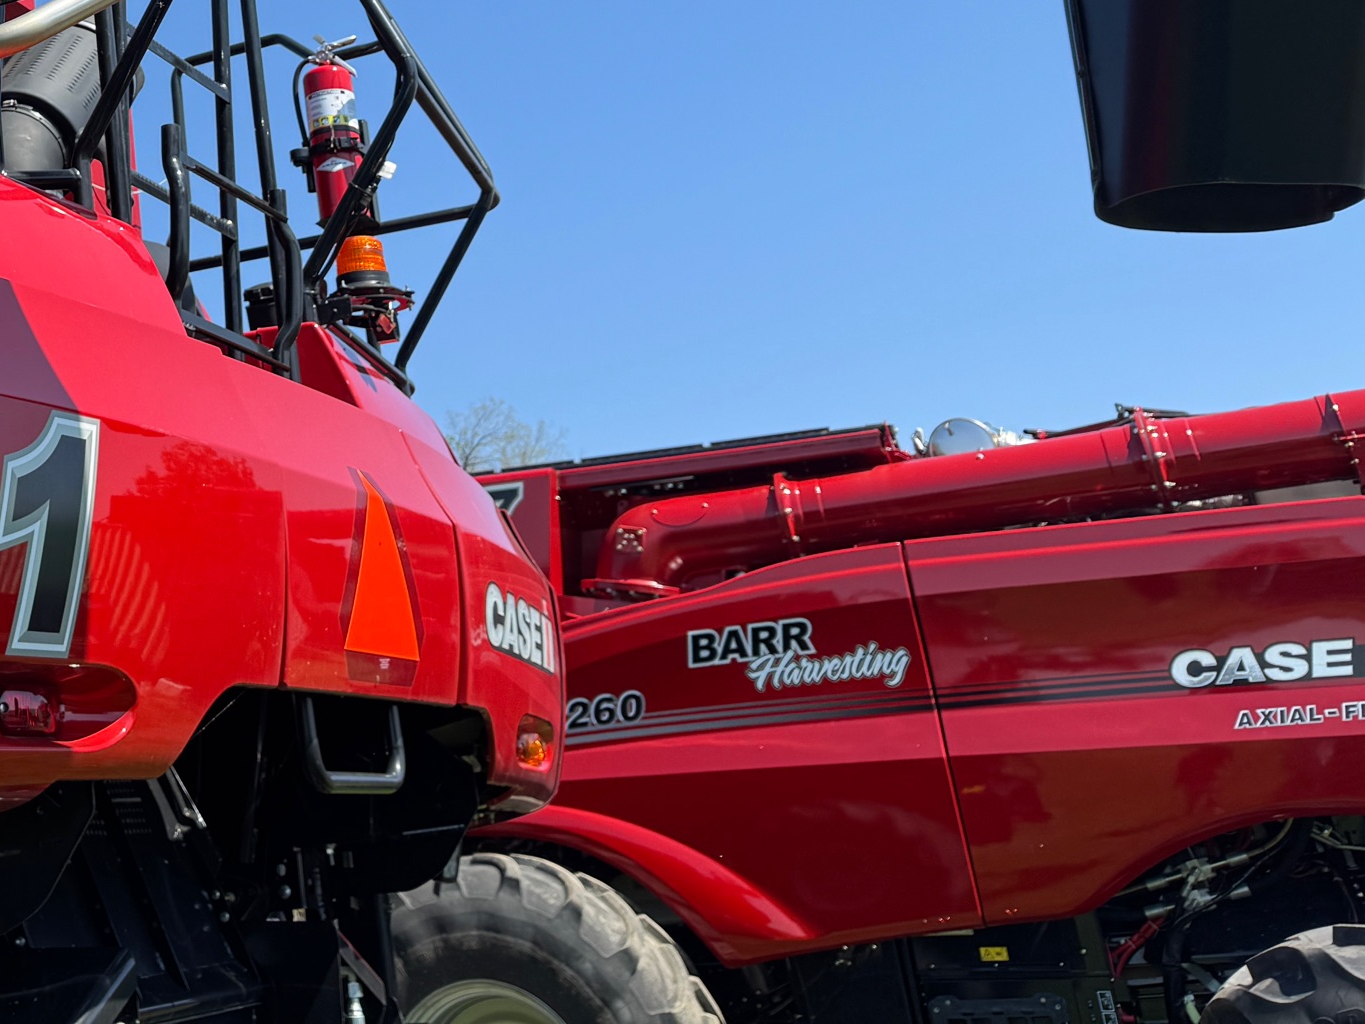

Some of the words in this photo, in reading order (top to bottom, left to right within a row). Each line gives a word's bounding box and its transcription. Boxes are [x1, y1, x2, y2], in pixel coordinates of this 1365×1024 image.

[485, 583, 543, 667] CASE
[686, 617, 818, 669] BARR
[747, 641, 912, 692] Harvesting
[1169, 638, 1355, 689] CASE
